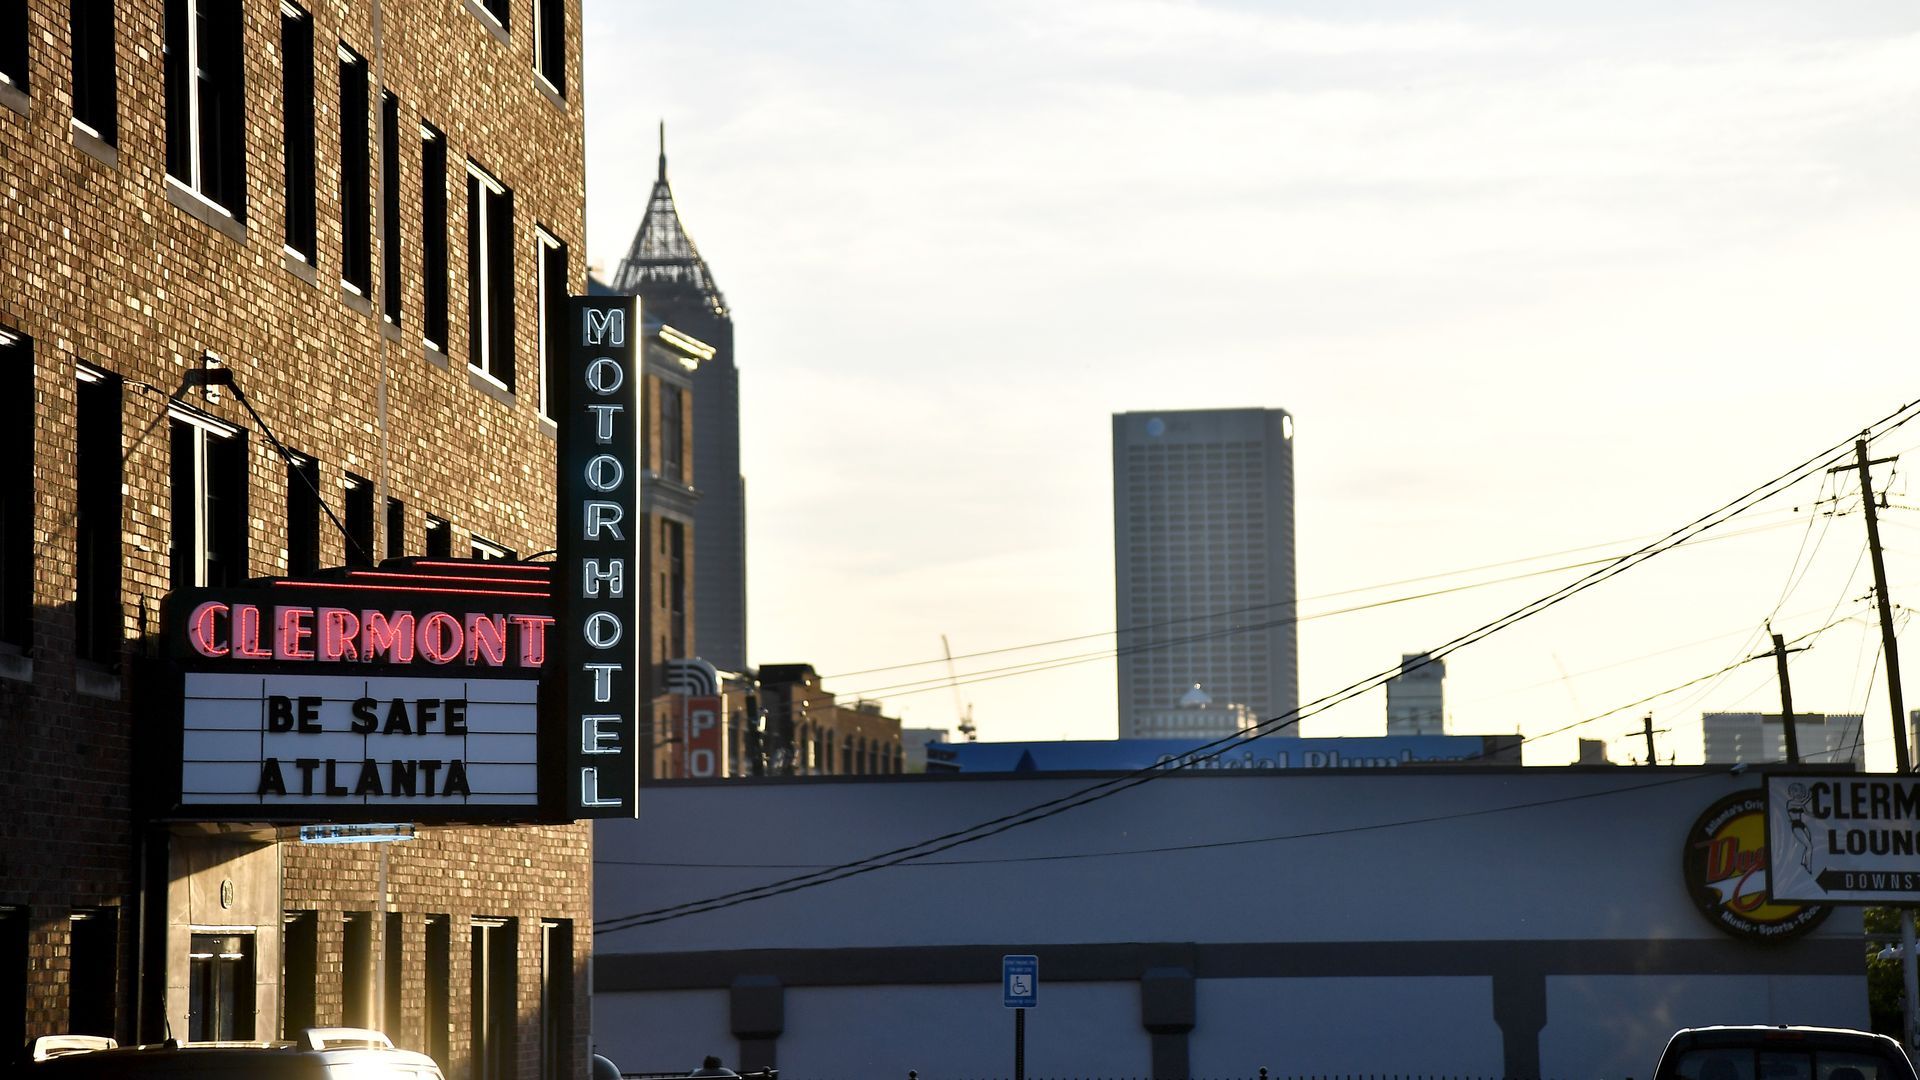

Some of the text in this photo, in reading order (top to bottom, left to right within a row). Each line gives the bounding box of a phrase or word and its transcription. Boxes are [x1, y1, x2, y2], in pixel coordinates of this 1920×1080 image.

[188, 600, 556, 667] CLERMONT
[268, 696, 468, 736] BE SAFE
[258, 757, 471, 797] ATLANTA
[1828, 829, 1920, 855] LOUN
[1720, 911, 1752, 932] Music
[1759, 921, 1794, 936] Sports
